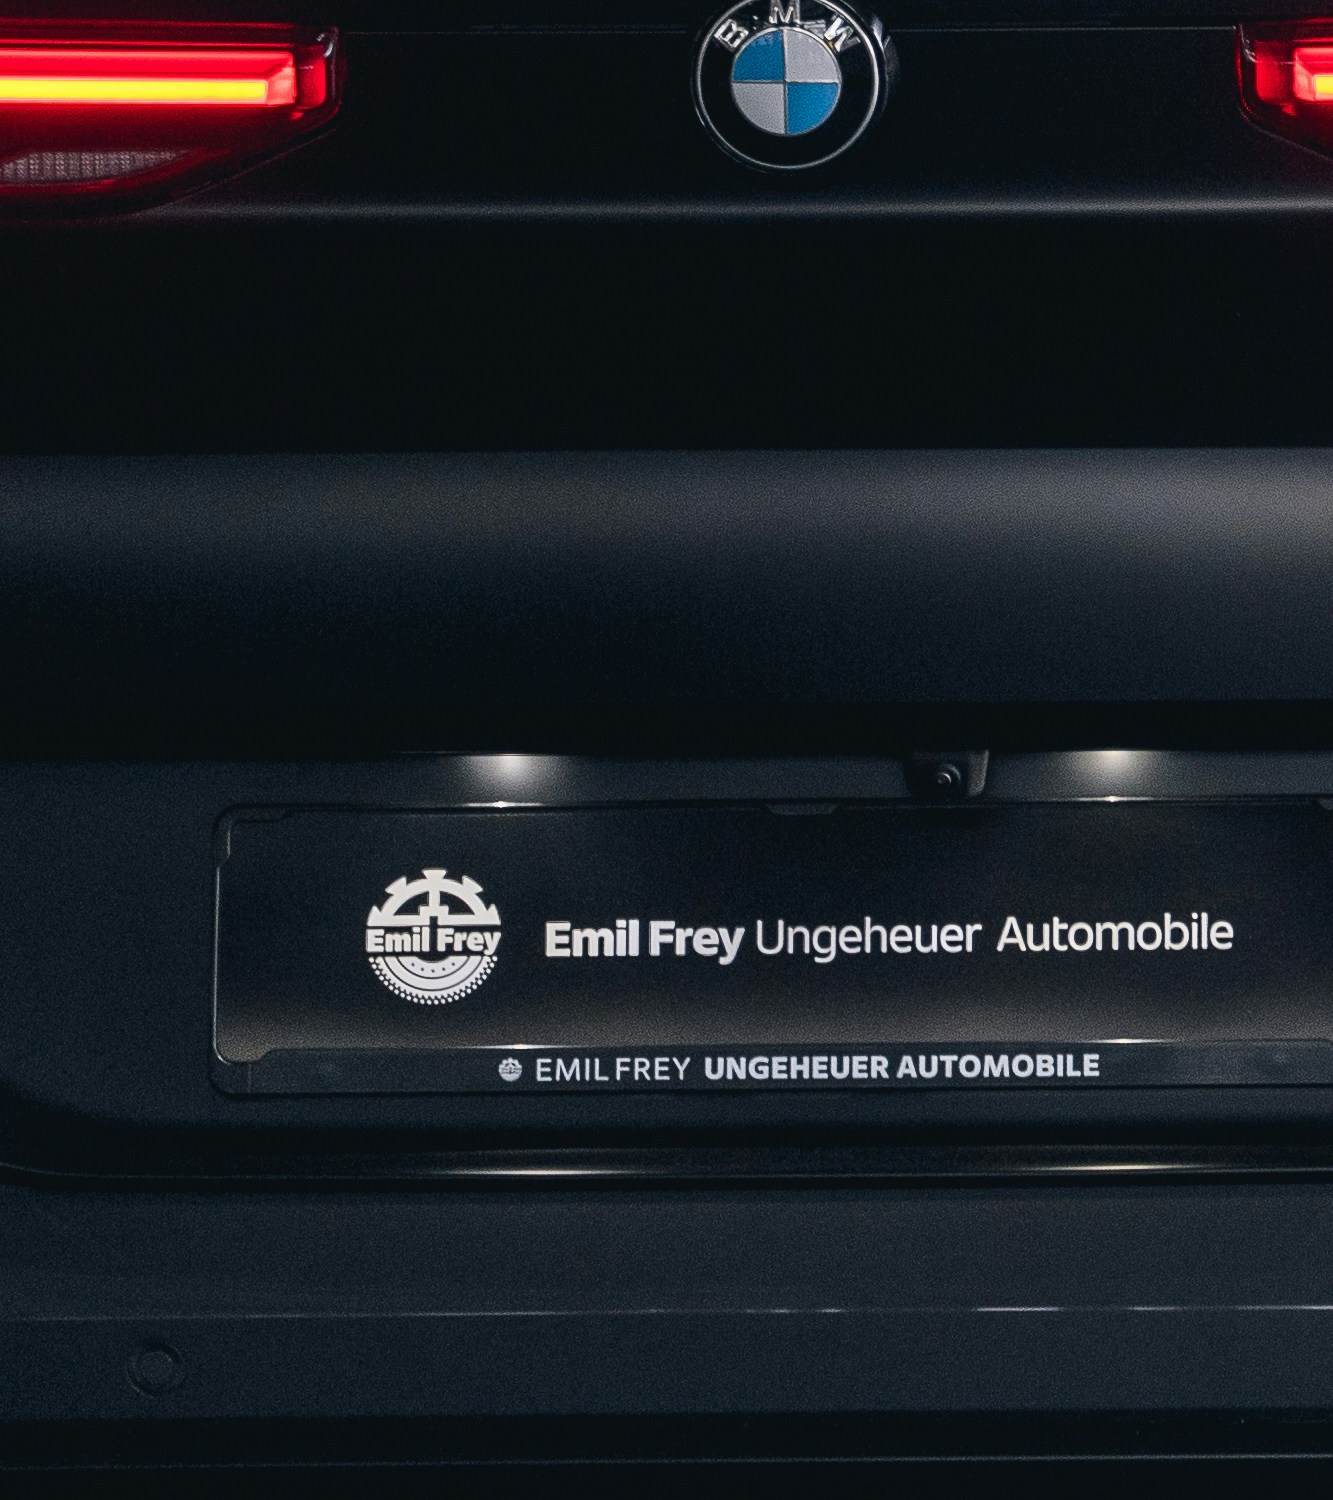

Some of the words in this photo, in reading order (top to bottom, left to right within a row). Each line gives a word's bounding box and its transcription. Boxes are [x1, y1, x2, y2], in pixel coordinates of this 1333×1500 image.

[366, 928, 430, 953] Emil
[437, 927, 501, 956] Frey
[545, 919, 640, 958] Emil
[649, 919, 745, 965] Frey
[756, 916, 983, 964] Ungeheuer
[996, 912, 1235, 953] Automobile
[535, 1056, 609, 1082] EMIL
[615, 1056, 691, 1081] FREY
[704, 1055, 889, 1080] UNGEHEUER
[897, 1053, 1100, 1078] AUTOMOBILE
